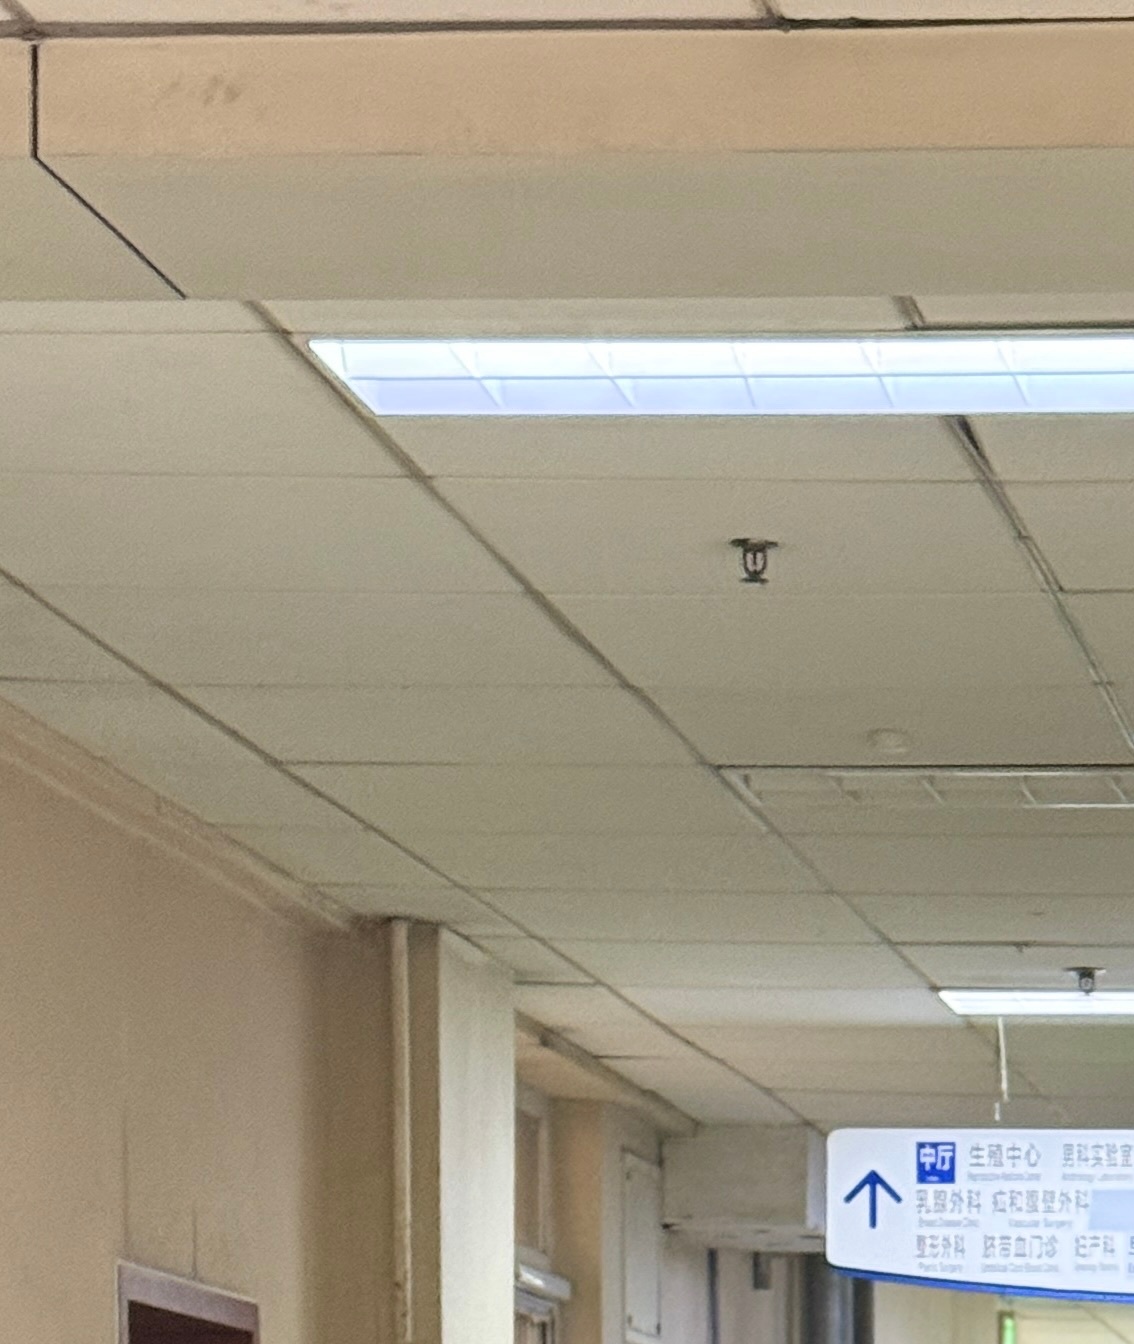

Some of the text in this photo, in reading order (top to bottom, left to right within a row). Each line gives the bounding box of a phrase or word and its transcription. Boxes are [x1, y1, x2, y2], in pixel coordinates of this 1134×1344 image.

[919, 1145, 953, 1171] 中厅
[969, 1142, 1042, 1168] 生殖中心
